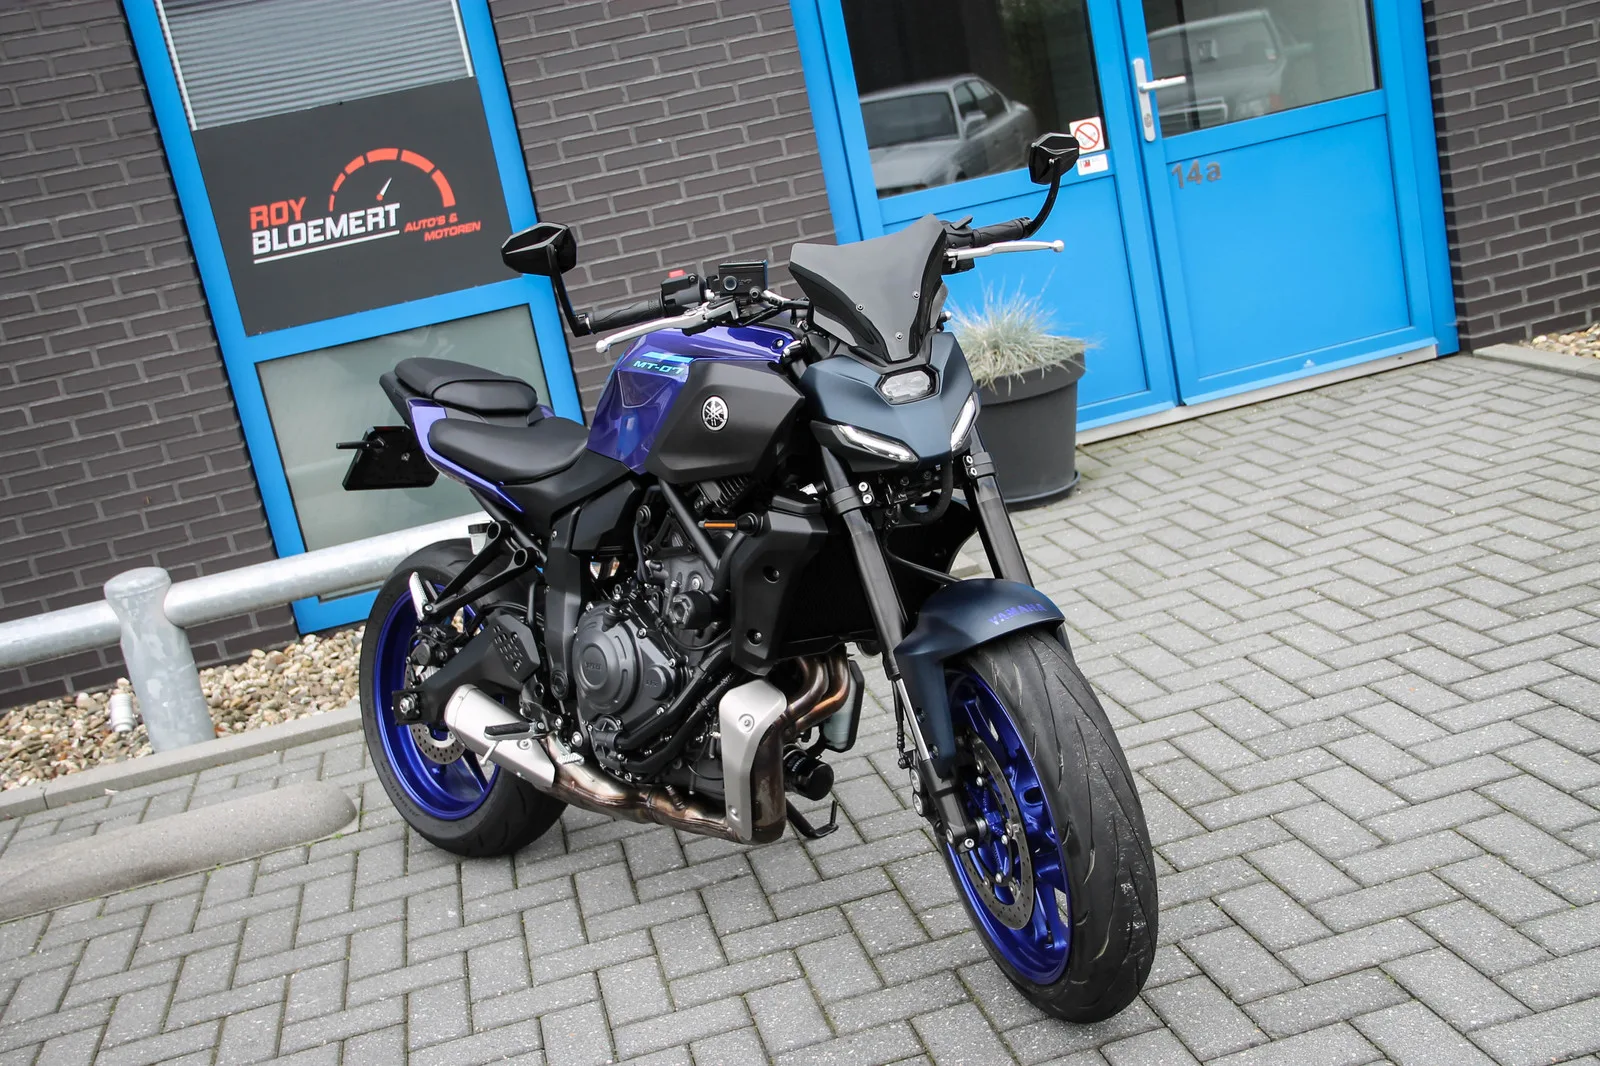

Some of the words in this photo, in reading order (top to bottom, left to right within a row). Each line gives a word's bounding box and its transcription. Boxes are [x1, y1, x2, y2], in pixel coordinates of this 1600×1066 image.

[1171, 159, 1222, 189] 14a
[250, 196, 306, 230] ROY
[404, 214, 446, 232] AUTO'S
[449, 213, 458, 223] &
[252, 202, 400, 255] BLOEMERT
[424, 221, 481, 242] MOTOREN
[633, 360, 684, 375] MT-07
[988, 603, 1047, 626] YAMAHA
